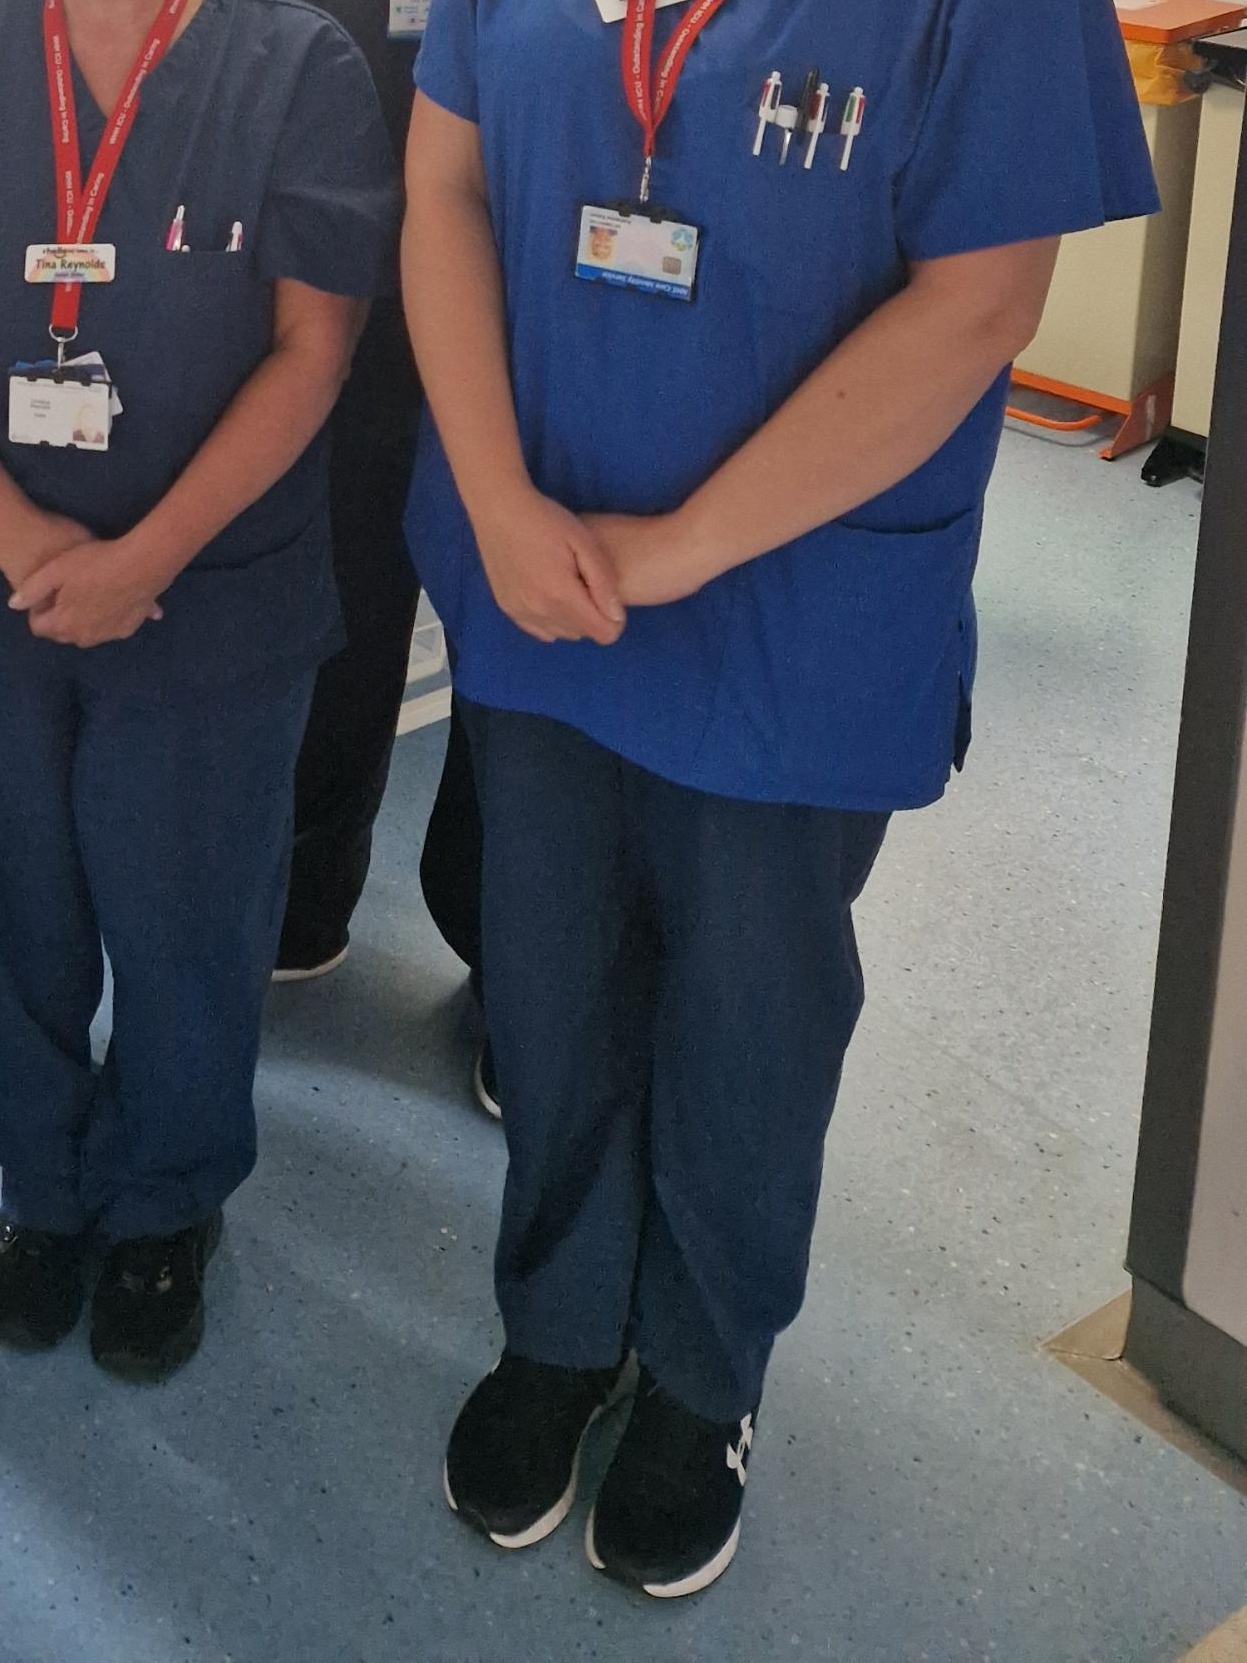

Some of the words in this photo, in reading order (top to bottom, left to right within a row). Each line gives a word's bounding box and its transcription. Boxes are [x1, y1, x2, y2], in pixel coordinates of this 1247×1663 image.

[689, 10, 702, 23] ICU
[632, 22, 644, 73] Outstanding
[660, 28, 689, 77] Outstanding
[115, 112, 126, 126] ICU
[123, 68, 146, 108] Outstanding
[144, 38, 160, 60] Caring
[634, 81, 642, 97] ICU
[56, 68, 66, 111] Outstanding
[61, 118, 69, 143] Caring
[89, 172, 104, 196] Caring
[36, 259, 56, 269] Tina
[61, 259, 105, 271] Reynolds
